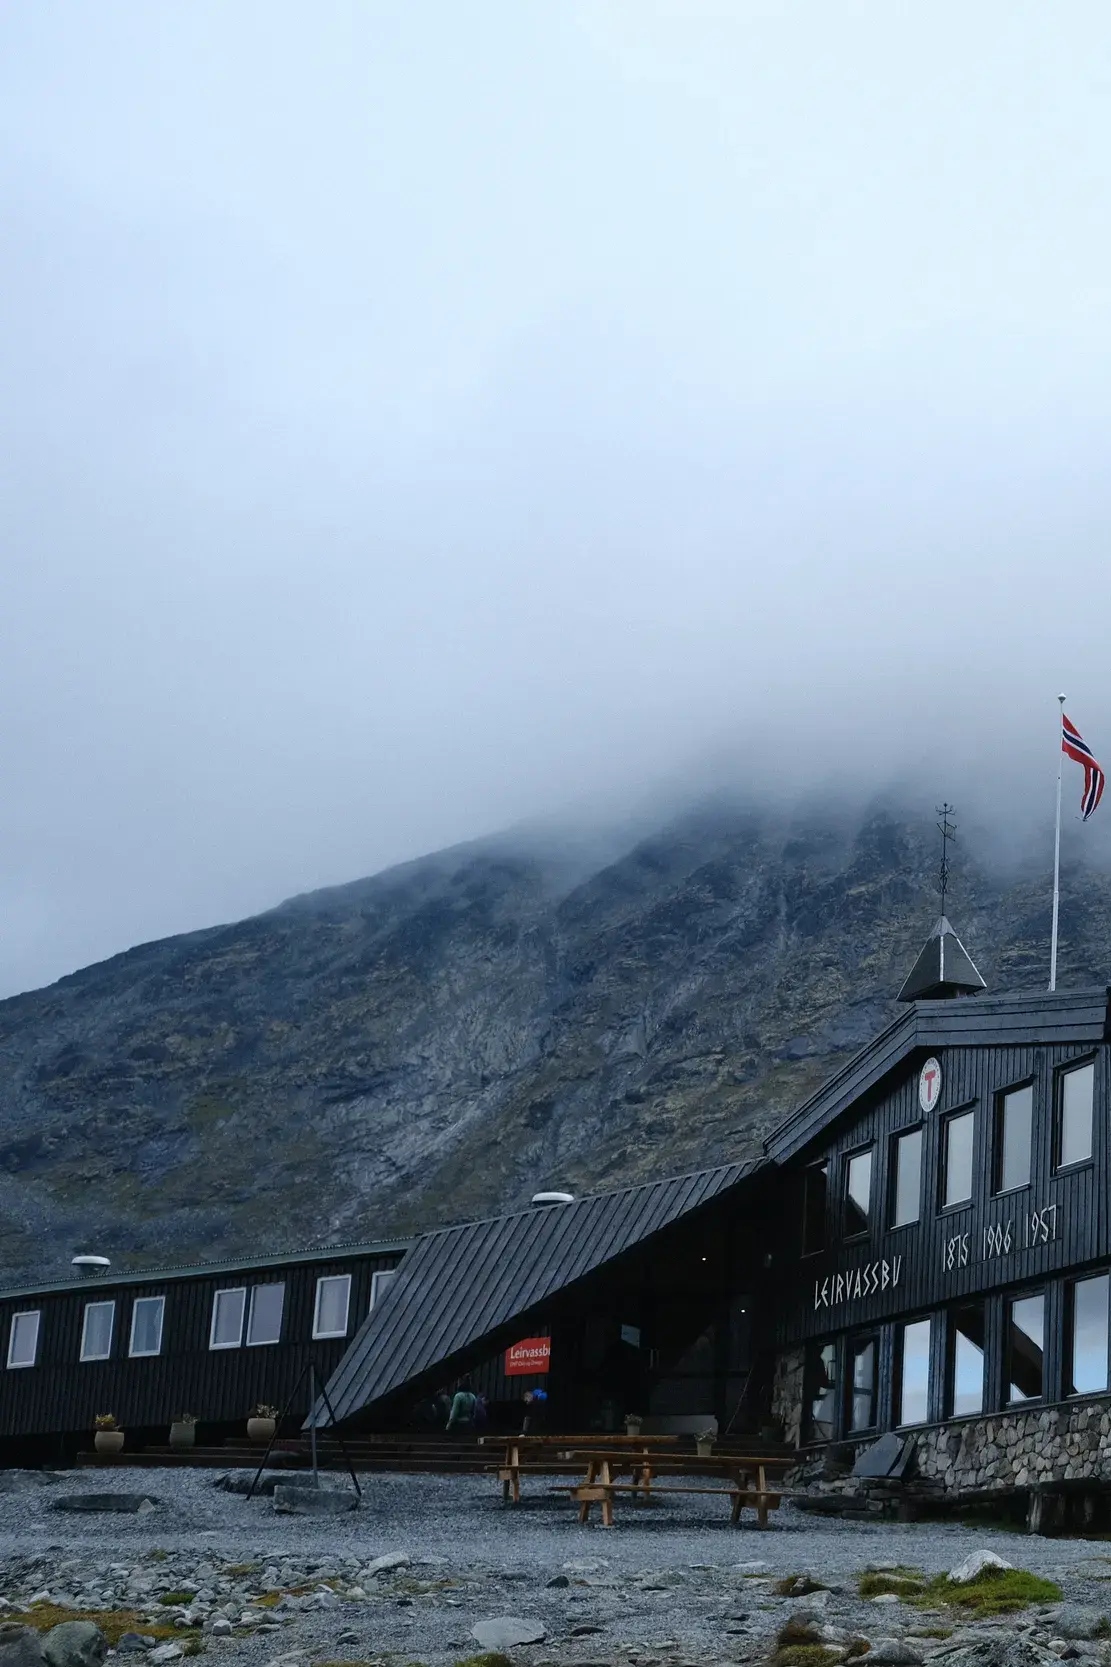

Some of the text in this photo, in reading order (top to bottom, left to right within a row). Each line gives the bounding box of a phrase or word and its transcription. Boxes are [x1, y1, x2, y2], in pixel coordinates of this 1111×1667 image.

[924, 1069, 936, 1102] T
[942, 1203, 1058, 1273] 1875 1906 1957
[814, 1254, 902, 1311] LEIRVASSBU
